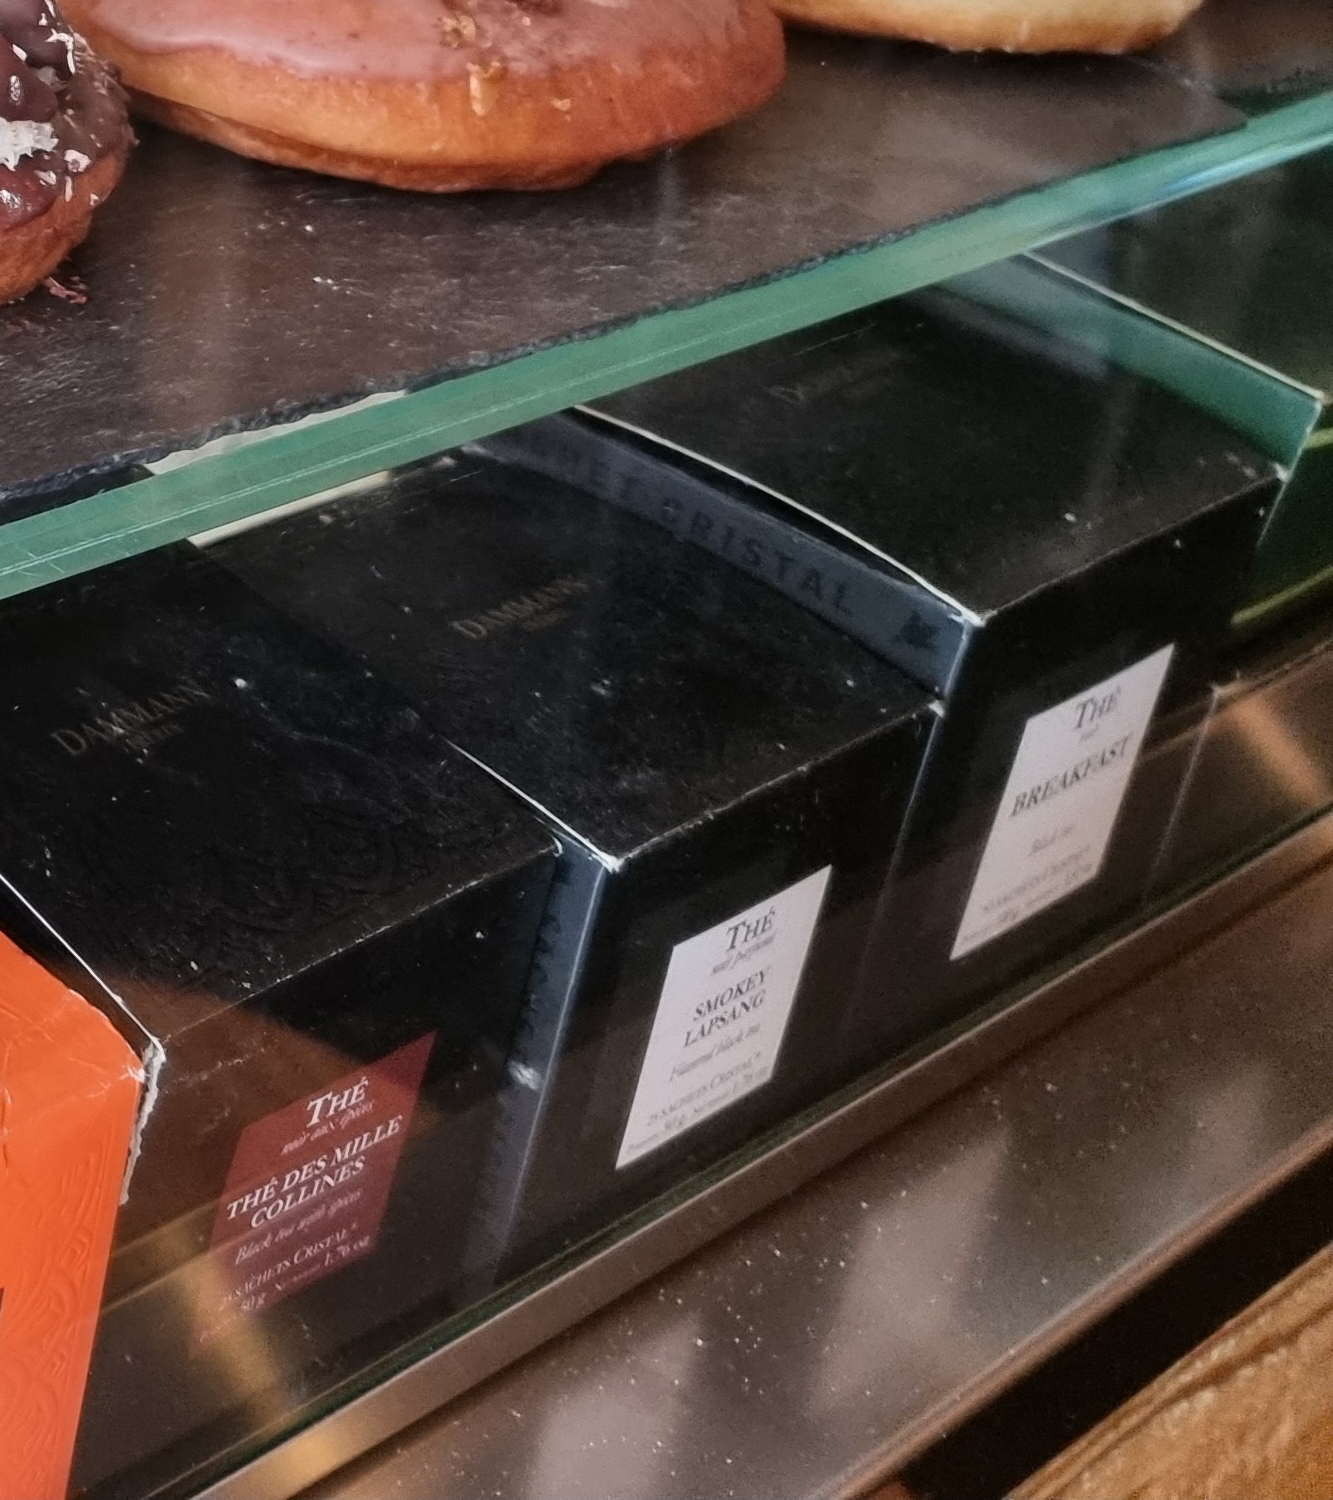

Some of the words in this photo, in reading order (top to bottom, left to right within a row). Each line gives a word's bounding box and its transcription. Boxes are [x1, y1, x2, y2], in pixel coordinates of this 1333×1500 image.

[660, 497, 853, 615] CRISTAL
[1008, 731, 1133, 818] BREAKFAST
[684, 987, 767, 1049] LAPSANG
[693, 964, 771, 1022] SMOKEY
[305, 1075, 370, 1128] THÉ
[226, 1176, 279, 1221] THÉ
[280, 1153, 329, 1193] DES
[329, 1113, 403, 1167] MILLE
[250, 1154, 367, 1229] COLLINES
